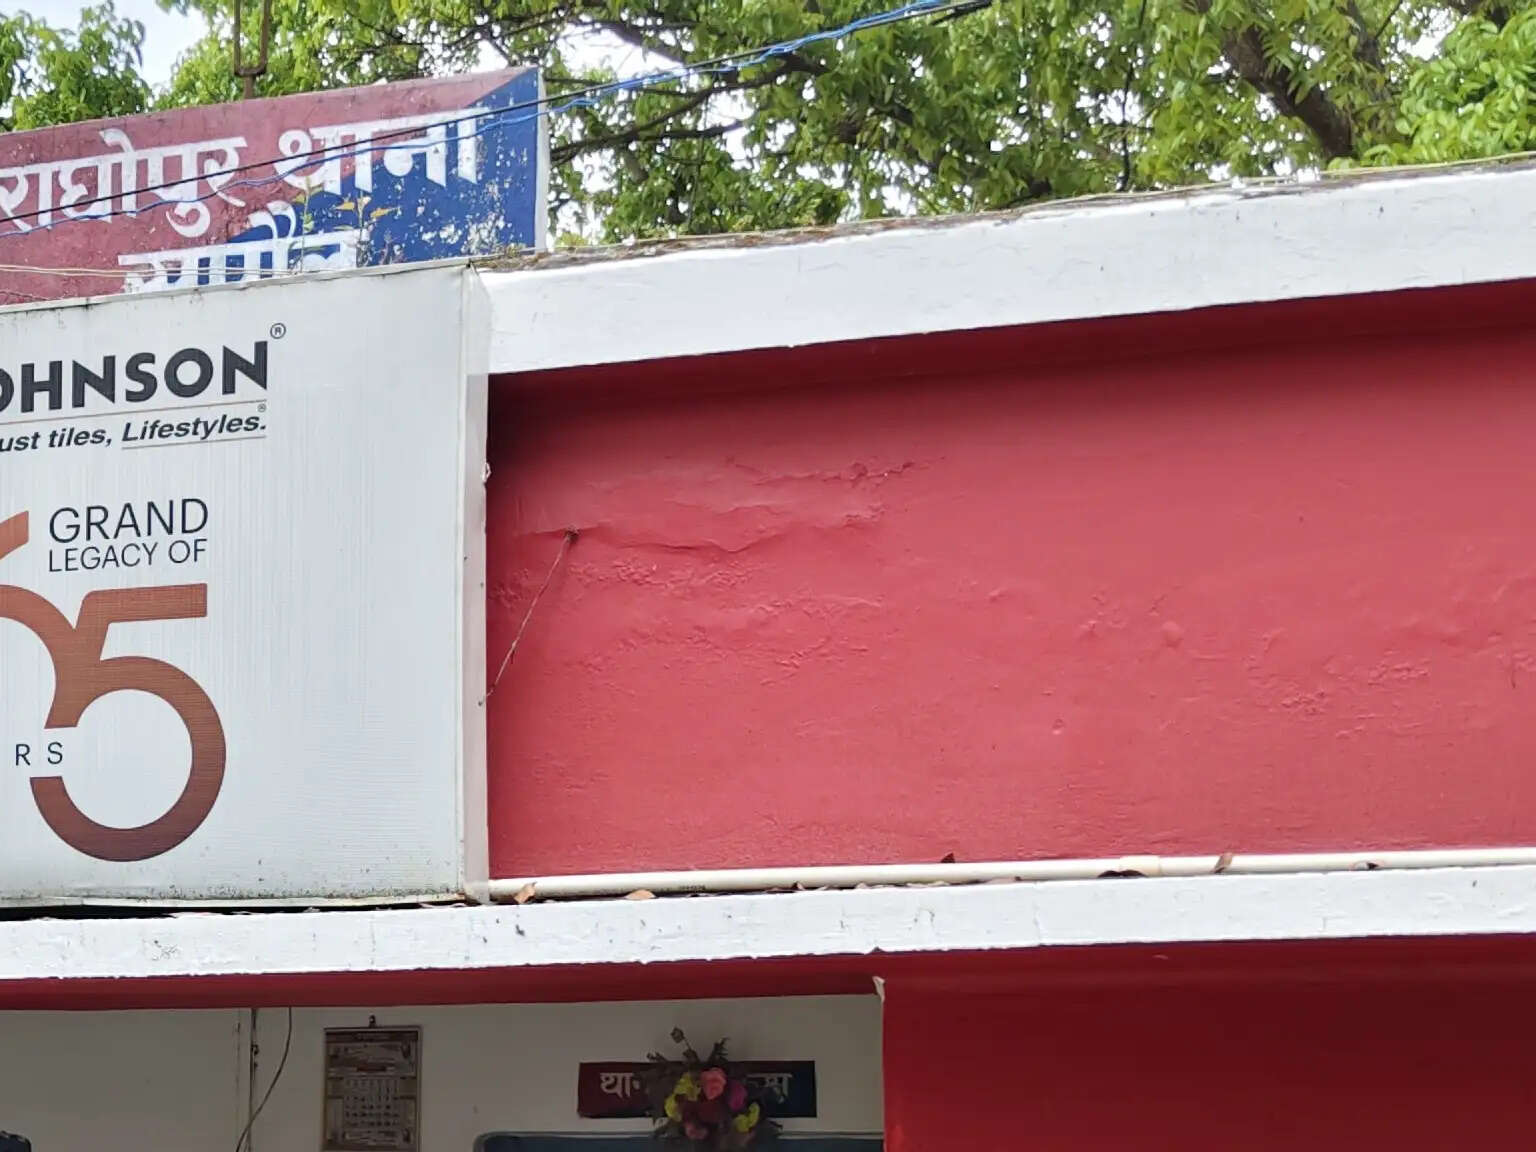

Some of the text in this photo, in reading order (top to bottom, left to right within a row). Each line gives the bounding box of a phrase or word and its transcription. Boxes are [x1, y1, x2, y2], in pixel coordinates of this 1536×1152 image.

[273, 107, 489, 196] थाना
[47, 428, 112, 450] tiles,
[121, 412, 268, 443] Lifestyles.
[48, 498, 209, 544] GRAND
[48, 539, 208, 573] LEGACY OF
